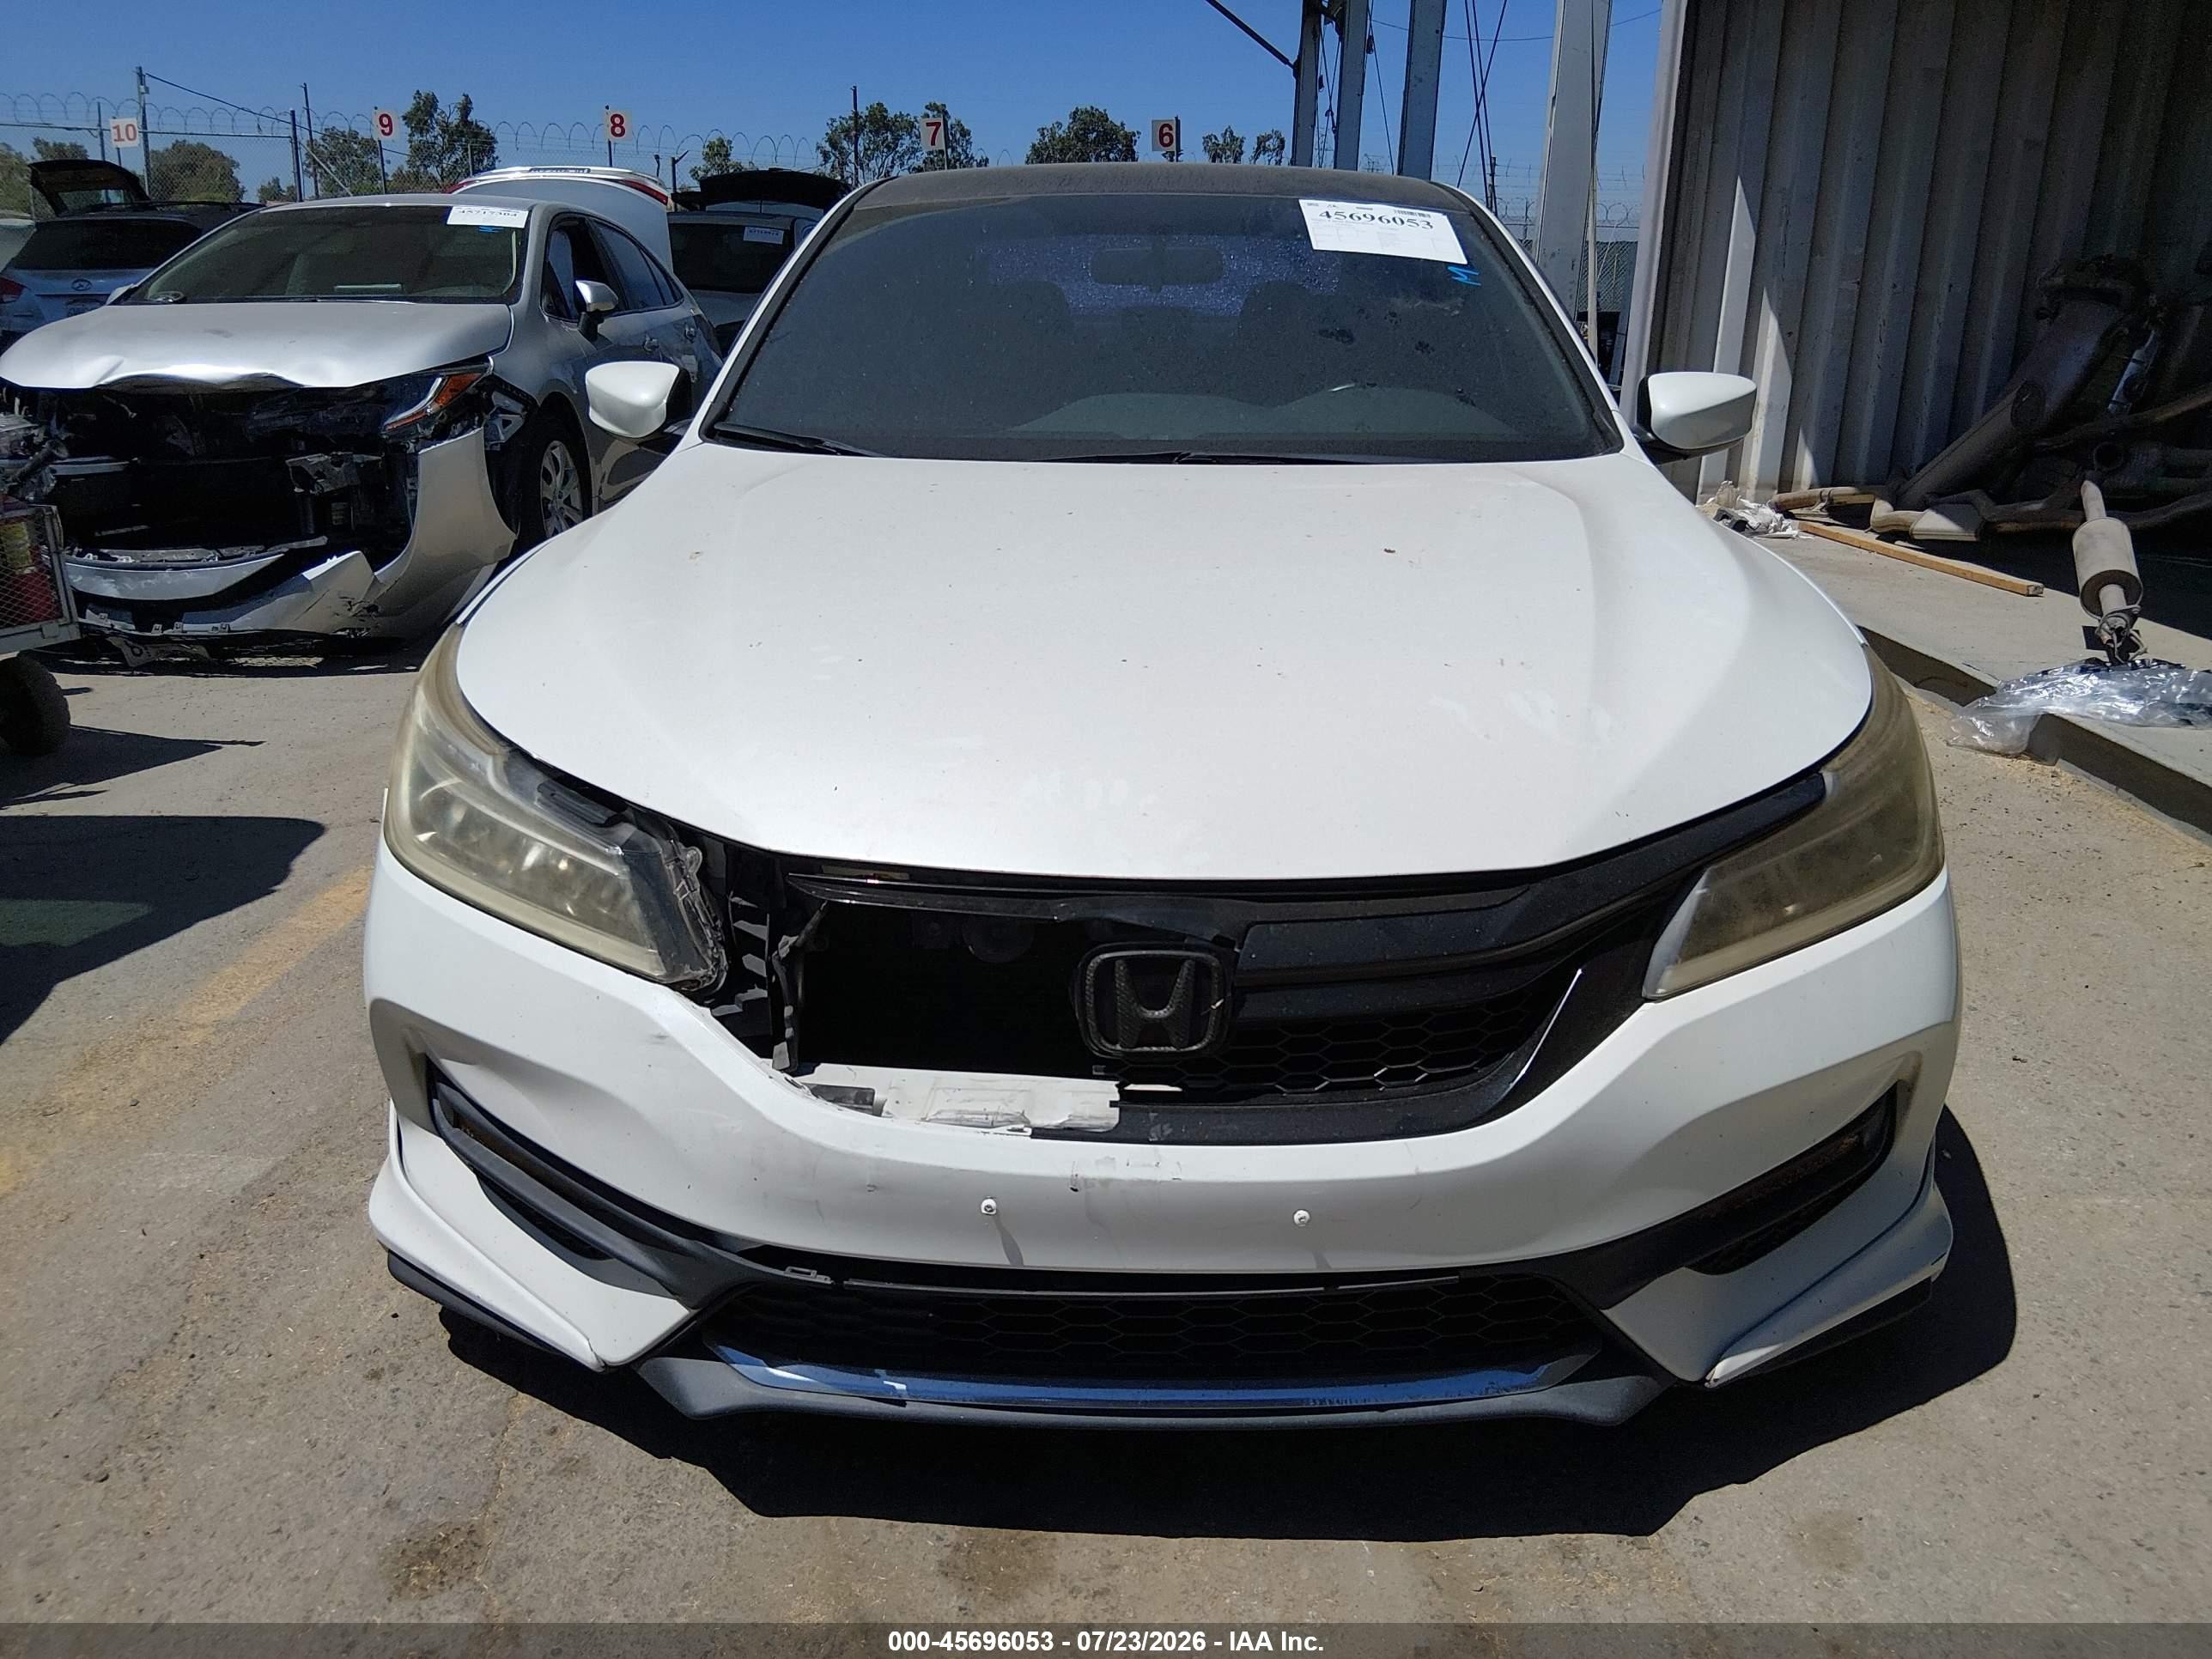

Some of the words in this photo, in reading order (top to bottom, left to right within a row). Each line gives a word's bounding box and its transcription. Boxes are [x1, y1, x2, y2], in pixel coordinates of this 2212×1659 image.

[112, 124, 137, 143] 10
[379, 113, 393, 137] 9
[611, 113, 626, 137] 8
[926, 122, 942, 146] 7
[1159, 124, 1174, 148] 6
[1318, 210, 1434, 230] 45696053
